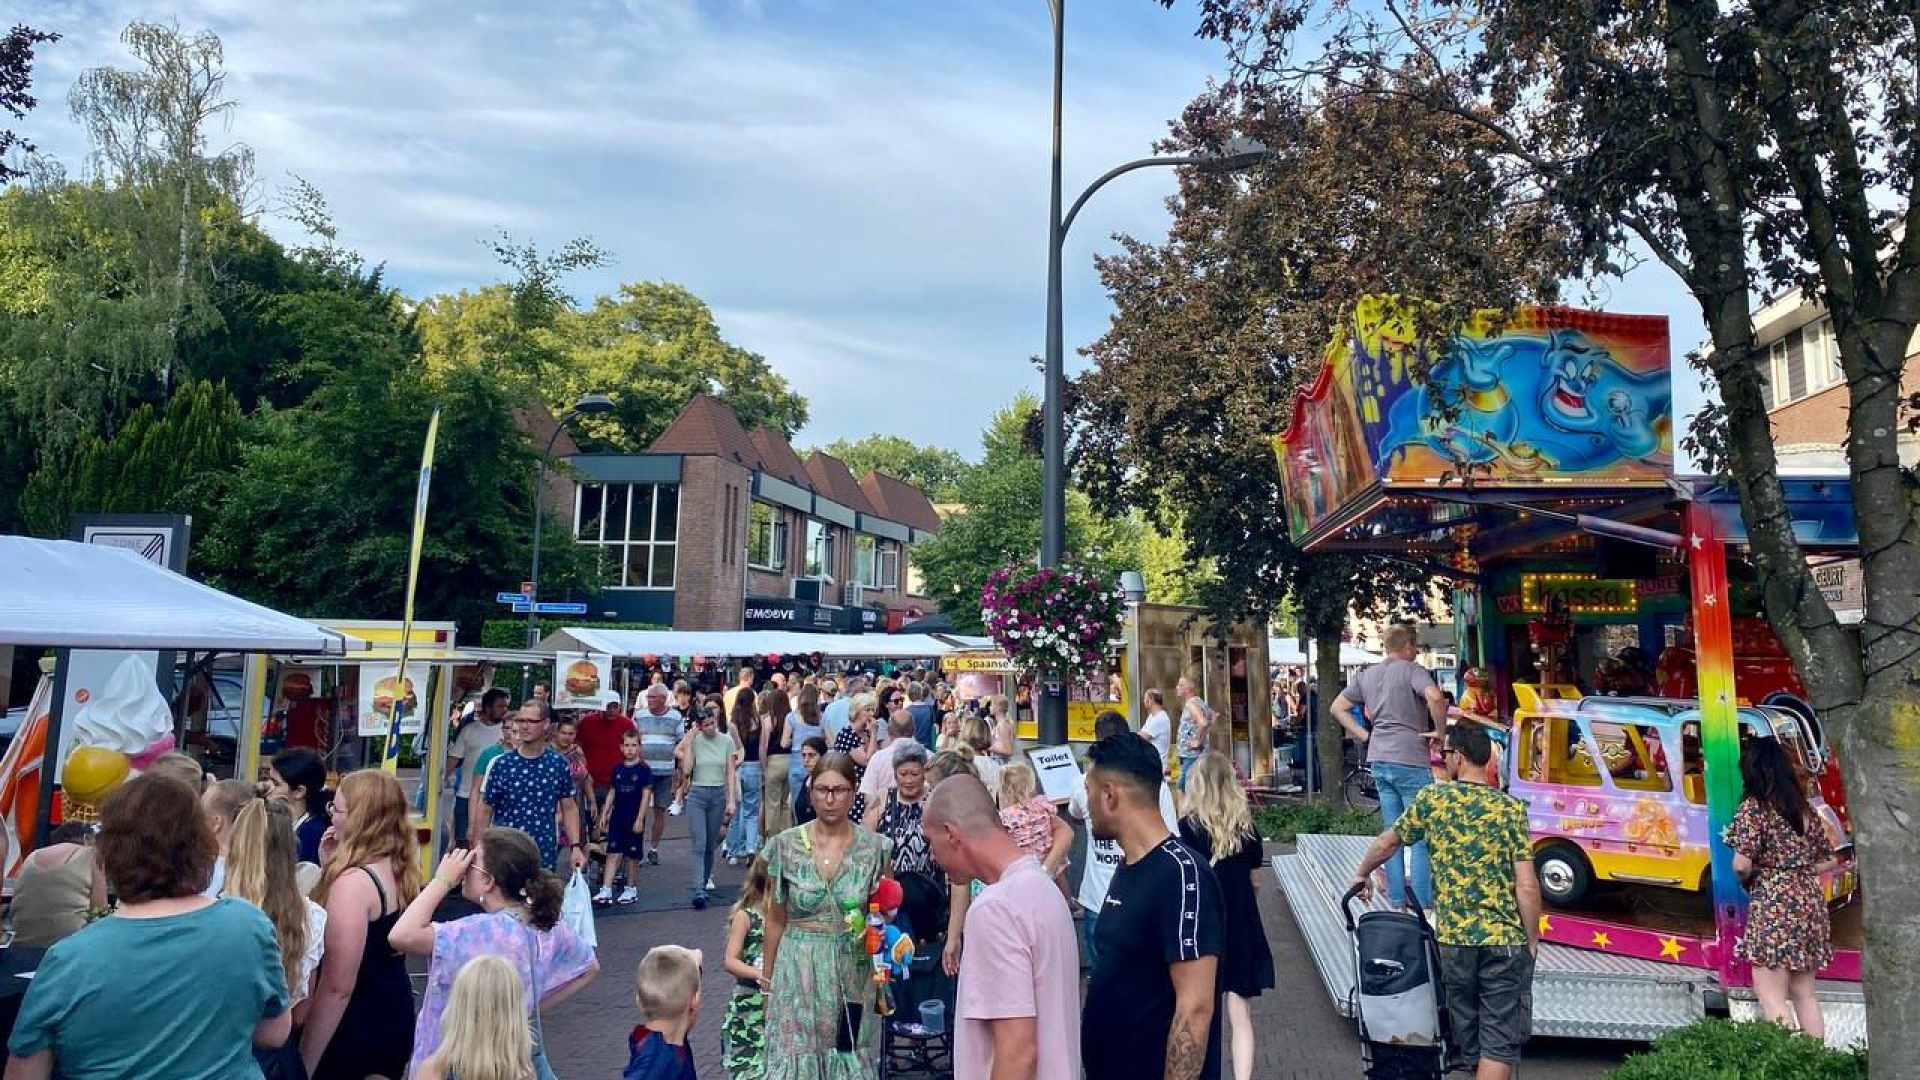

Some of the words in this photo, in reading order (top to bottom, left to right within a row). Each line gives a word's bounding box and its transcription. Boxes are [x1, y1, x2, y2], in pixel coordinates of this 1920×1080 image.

[1537, 579, 1620, 605] kassa
[967, 659, 1009, 670] Spaanse
[1036, 752, 1069, 765] Toilet
